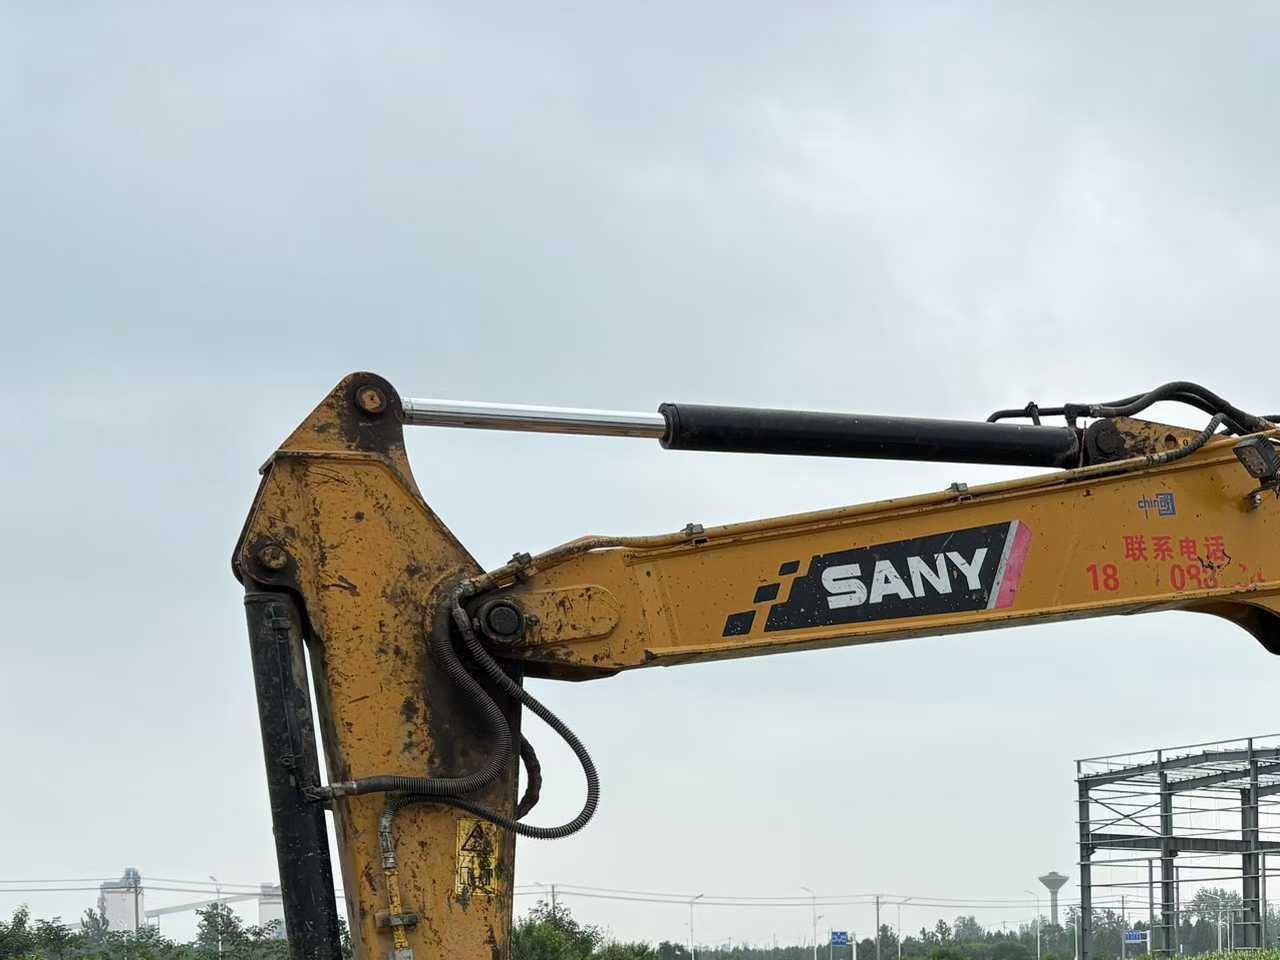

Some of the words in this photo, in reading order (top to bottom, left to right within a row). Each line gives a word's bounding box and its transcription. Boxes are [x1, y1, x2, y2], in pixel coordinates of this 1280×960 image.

[1123, 535, 1226, 563] 联系电话
[821, 547, 988, 610] SANY
[1086, 562, 1121, 592] 18
